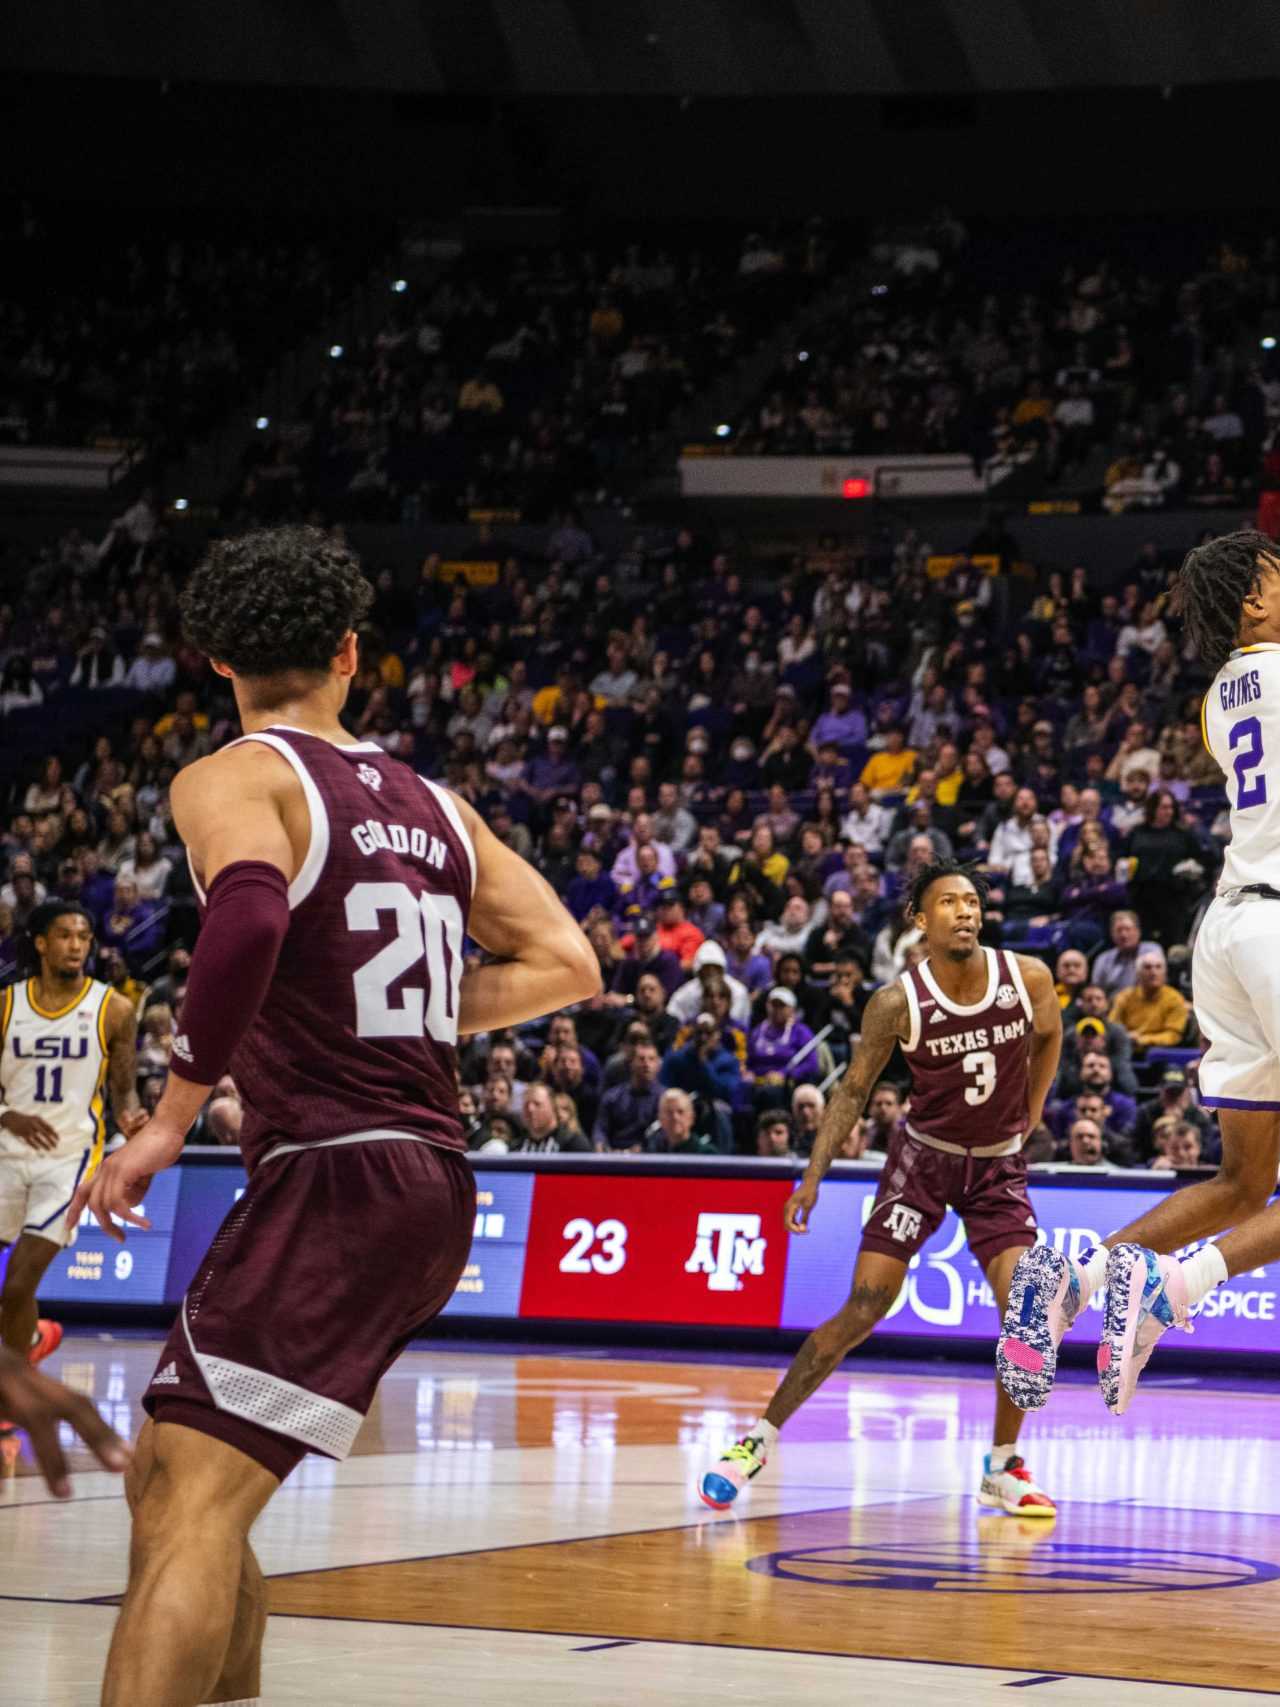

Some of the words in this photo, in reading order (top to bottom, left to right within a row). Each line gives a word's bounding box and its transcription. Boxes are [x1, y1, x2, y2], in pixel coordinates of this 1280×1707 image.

[1220, 669, 1262, 712] GAINES
[1229, 716, 1267, 811] 2
[344, 882, 465, 1047] 20
[12, 1036, 89, 1059] LSU
[925, 1029, 989, 1058] TEXAS
[992, 1018, 1027, 1045] A&M
[33, 1065, 64, 1103] 11
[961, 1050, 998, 1107] 3
[114, 1250, 134, 1280] 9
[558, 1217, 629, 1275] 23
